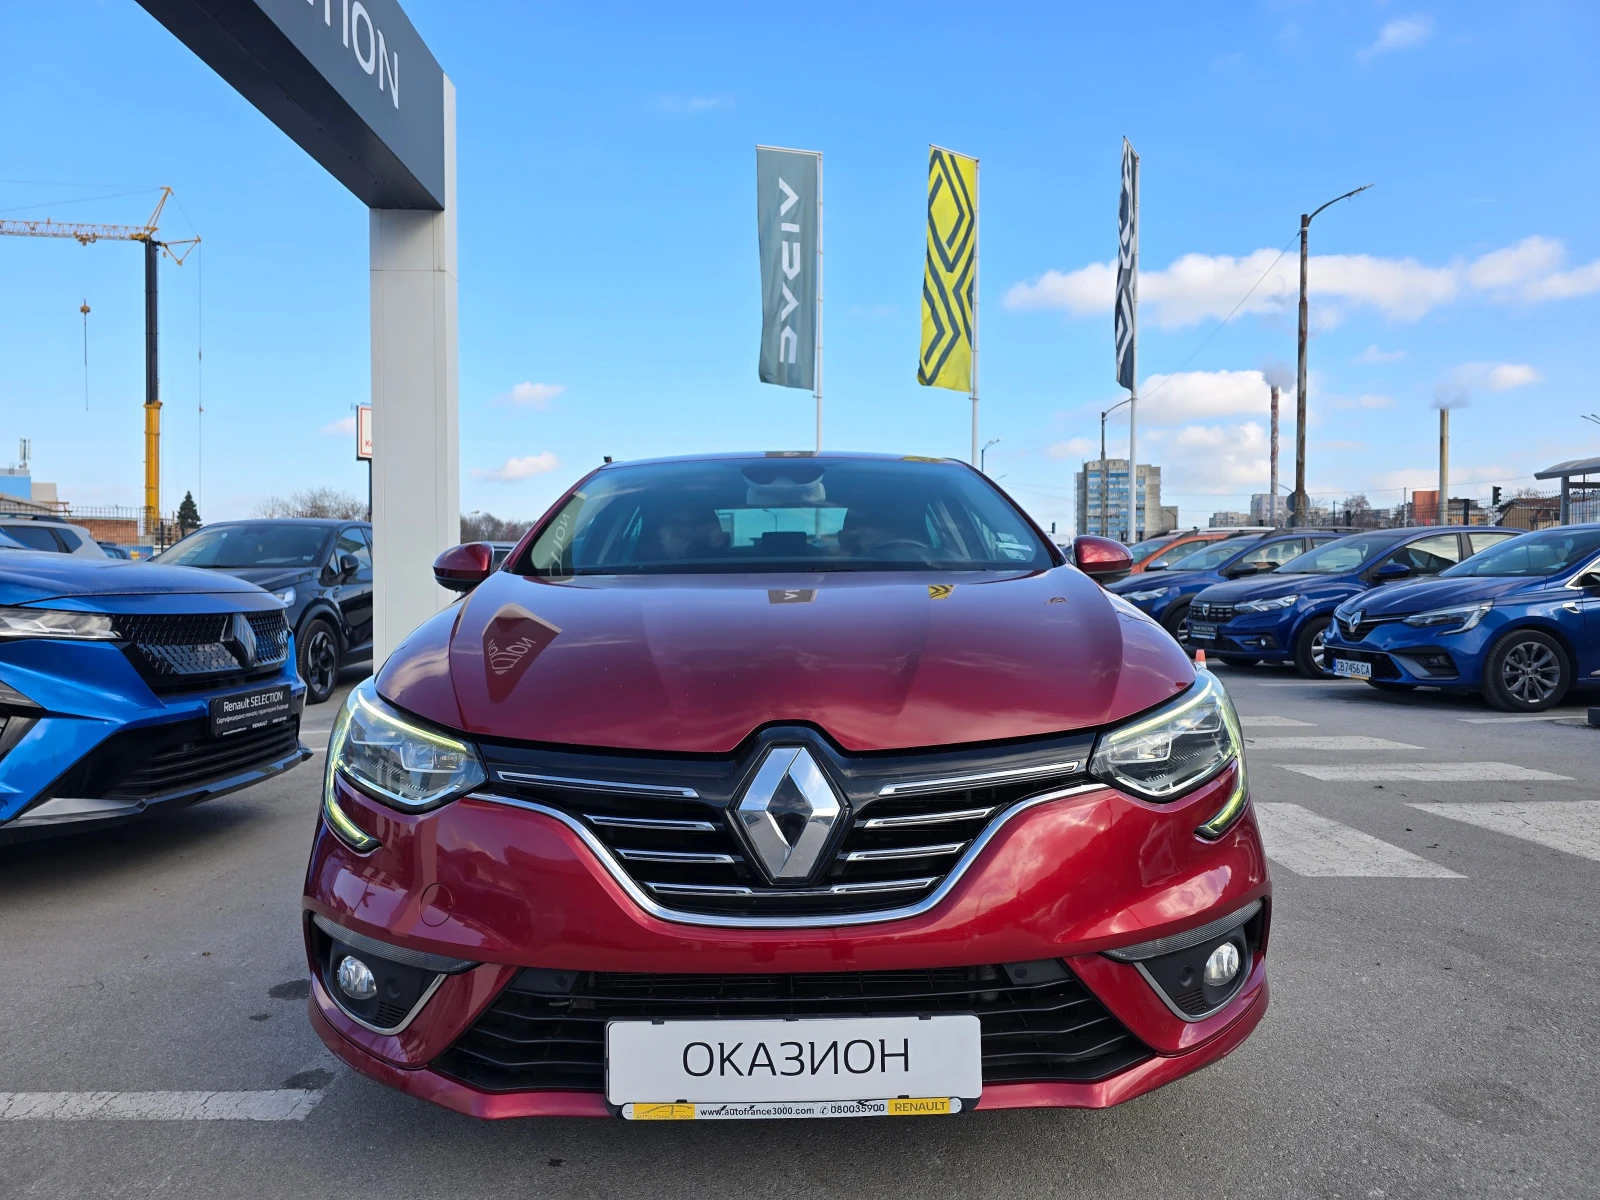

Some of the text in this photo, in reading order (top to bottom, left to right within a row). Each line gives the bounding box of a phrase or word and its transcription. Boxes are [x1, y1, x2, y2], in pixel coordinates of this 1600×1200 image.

[223, 691, 284, 712] Renault SELECTION
[682, 1037, 909, 1077] ОКАЗИОН
[700, 1105, 814, 1116] www.autofrance3000.com
[894, 1101, 947, 1112] RENAULT
